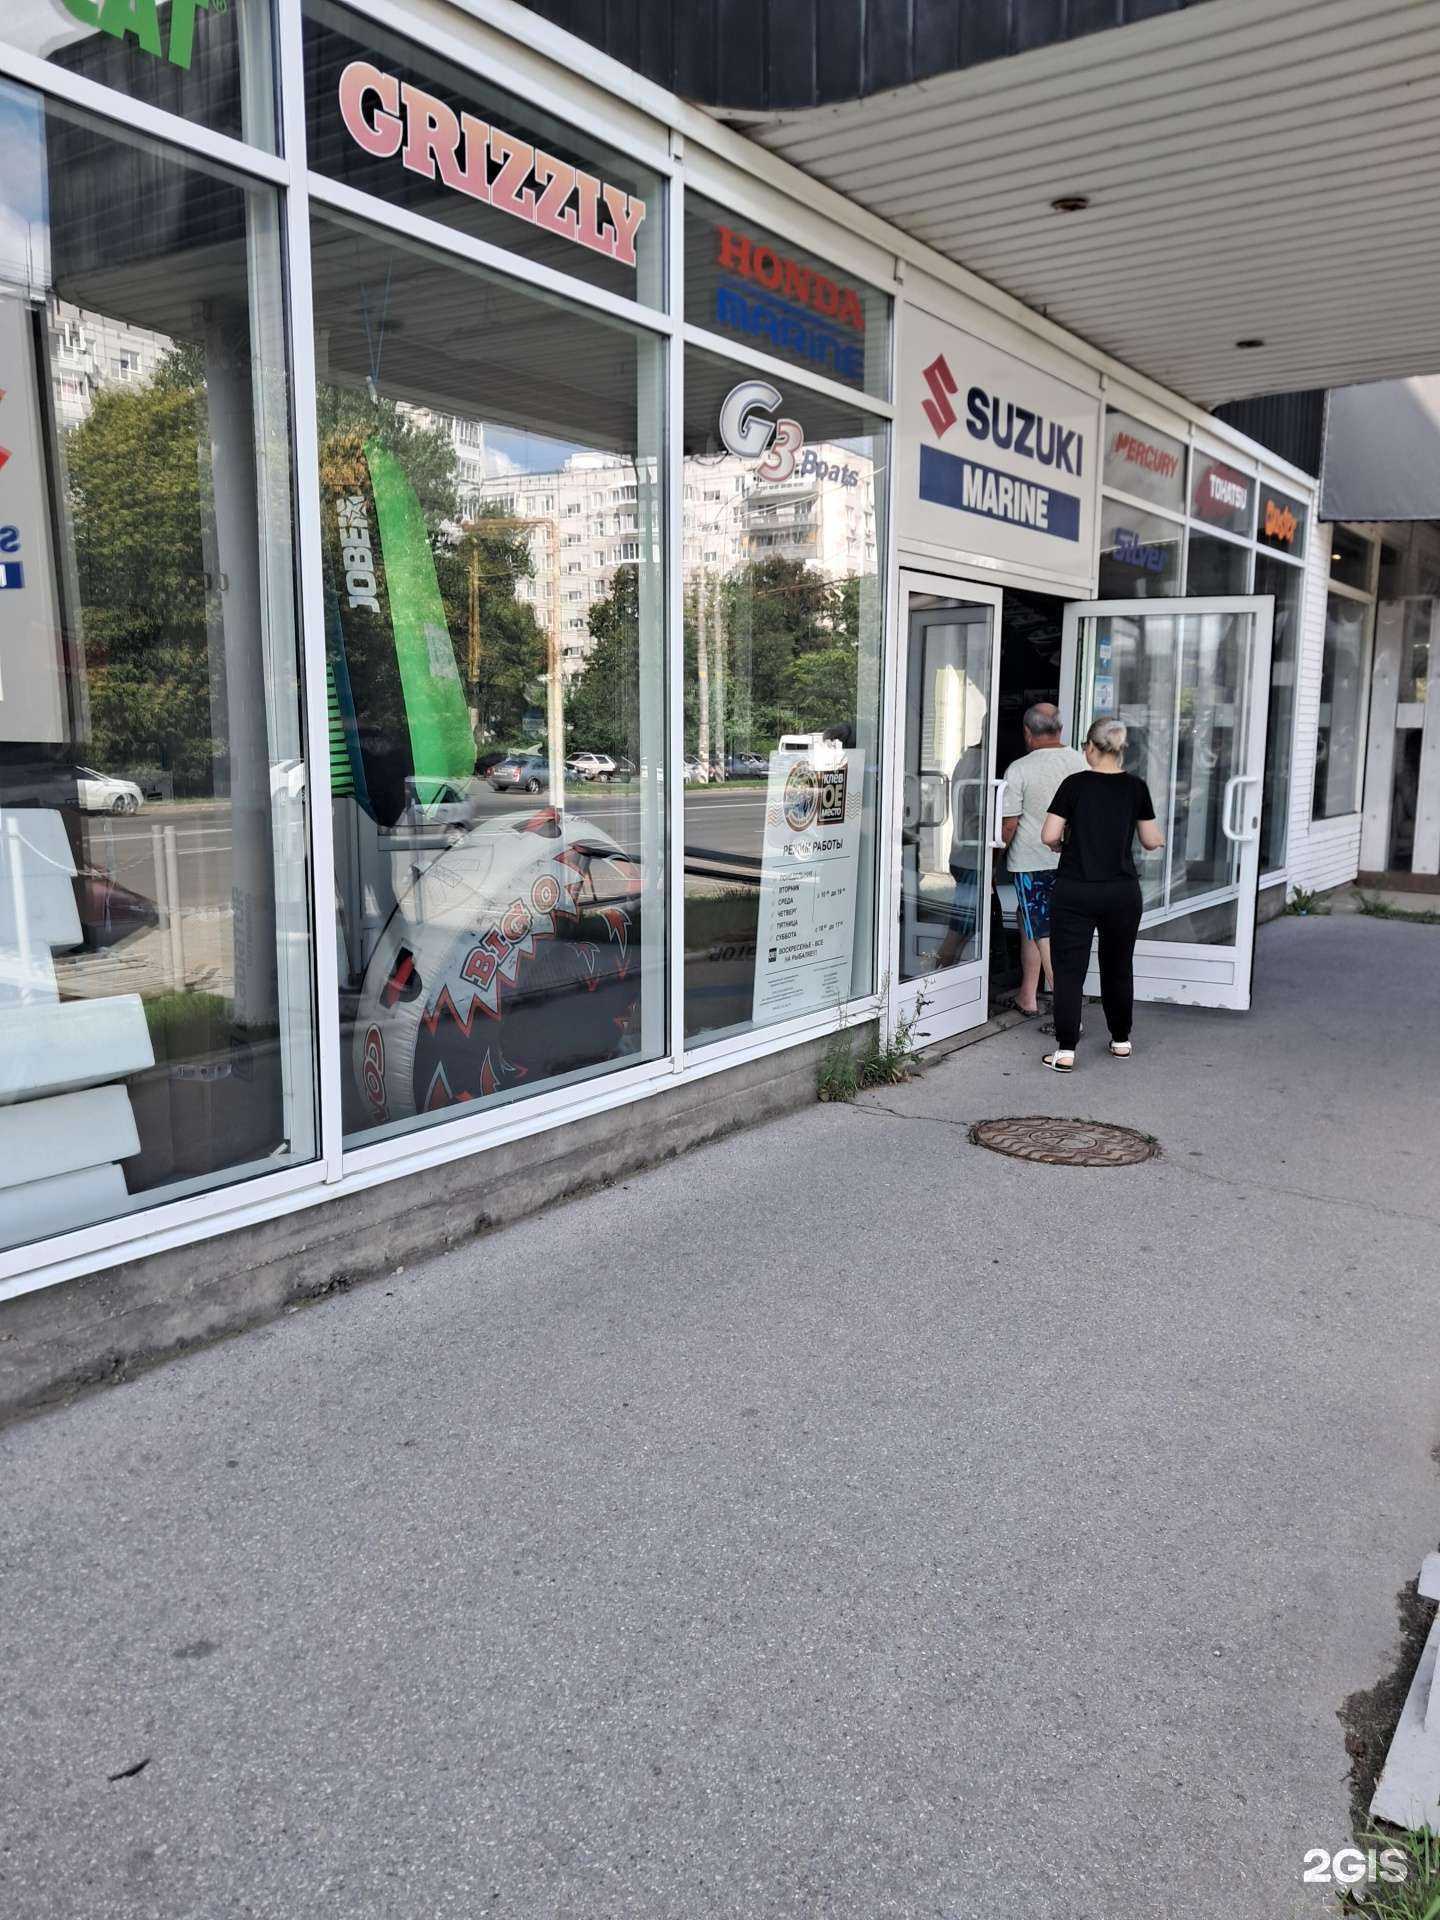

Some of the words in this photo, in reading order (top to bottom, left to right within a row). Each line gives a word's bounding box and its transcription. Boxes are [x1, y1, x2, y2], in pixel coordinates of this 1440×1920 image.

[339, 61, 646, 267] GRIZZLY
[716, 225, 865, 331] HONDA
[966, 386, 1084, 477] SUZUKI
[1113, 431, 1179, 479] MERCURY
[801, 449, 860, 488] Boats
[962, 463, 1050, 529] MARINE
[1209, 474, 1248, 511] TOHATSU
[812, 838, 844, 851] РАБОТЫ
[460, 898, 533, 992] BIG
